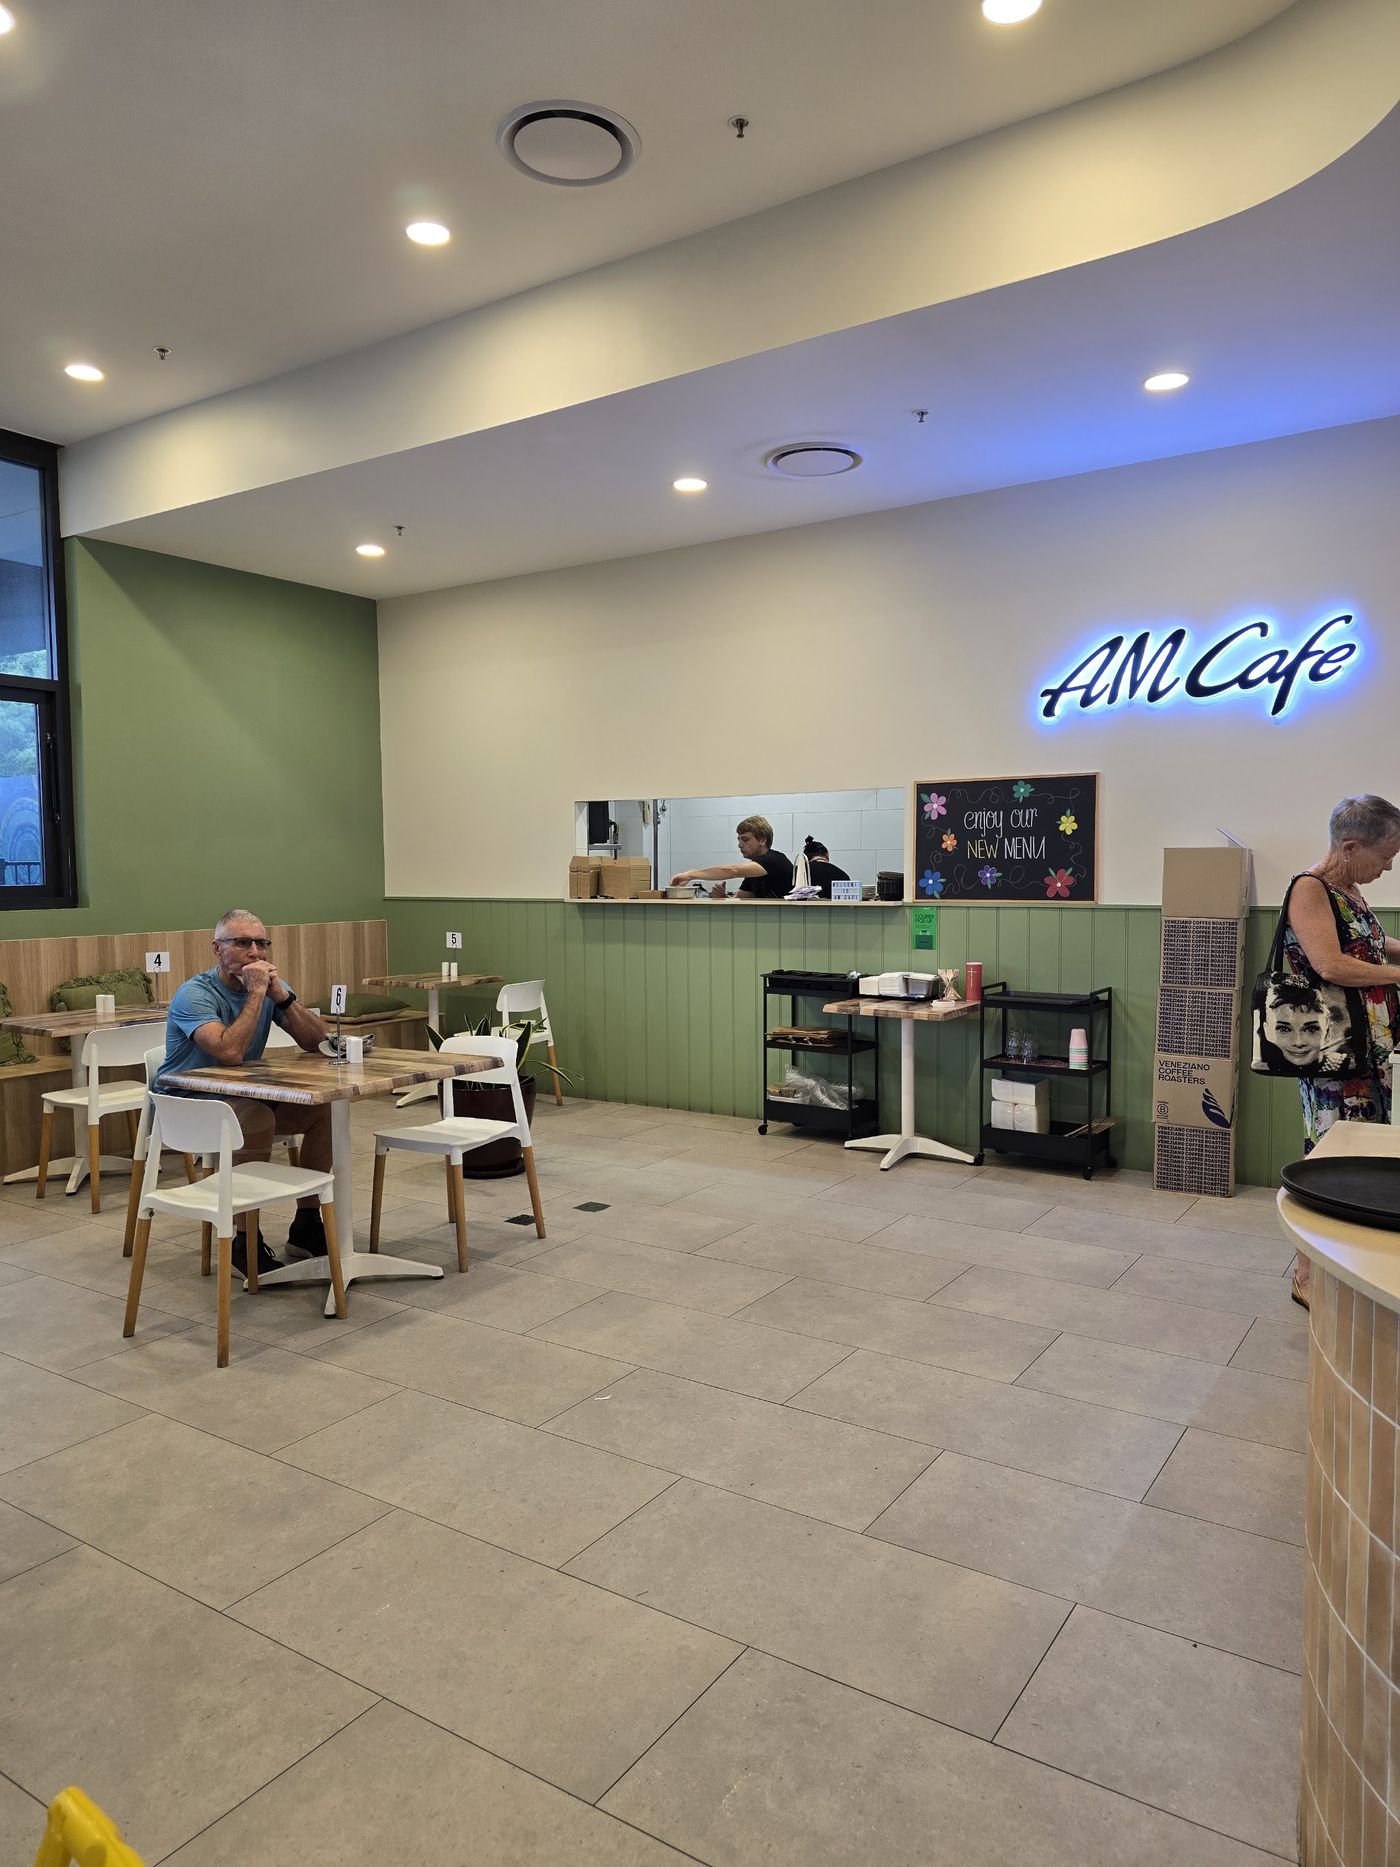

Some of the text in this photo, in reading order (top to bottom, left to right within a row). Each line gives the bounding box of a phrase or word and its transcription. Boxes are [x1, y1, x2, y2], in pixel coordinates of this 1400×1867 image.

[1040, 614, 1356, 718] AM Cafe
[963, 807, 1038, 838] enjoy our
[967, 836, 1046, 860] NEW MENU
[452, 934, 457, 944] 5
[154, 954, 161, 966] 4
[336, 988, 341, 1005] 6
[1158, 1060, 1210, 1071] VENEZIANO
[1158, 1068, 1193, 1076] COFFEE
[1158, 1074, 1206, 1084] ROASTERS
